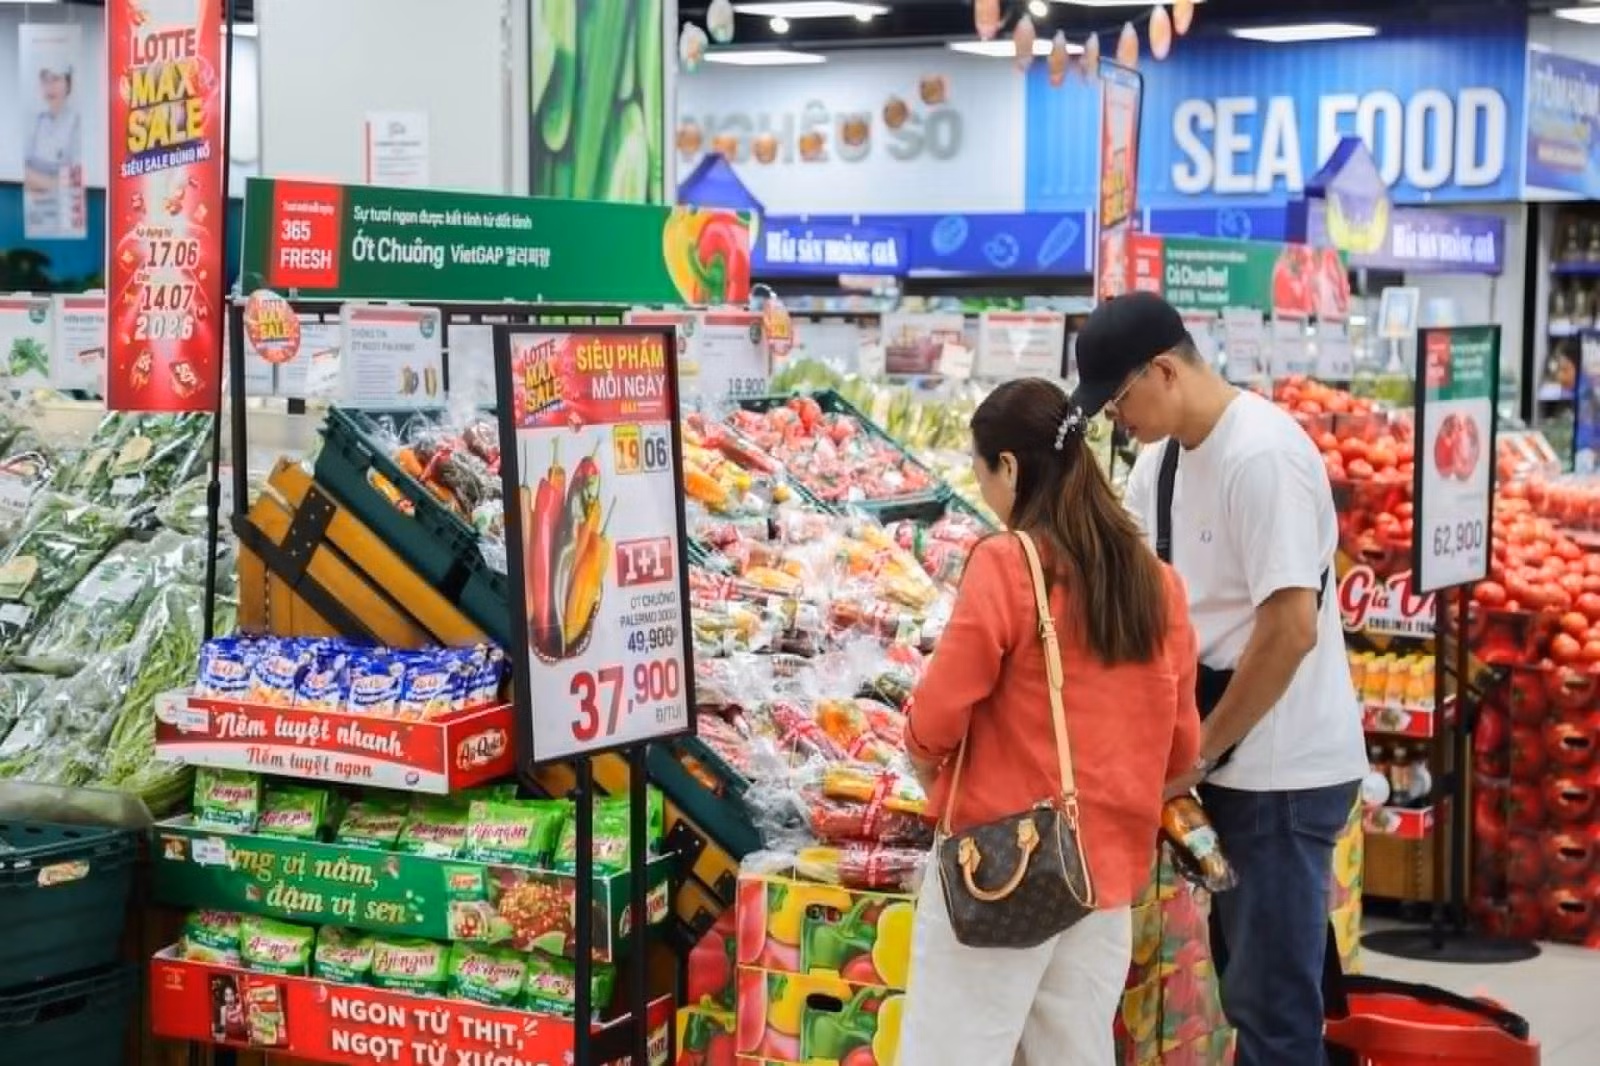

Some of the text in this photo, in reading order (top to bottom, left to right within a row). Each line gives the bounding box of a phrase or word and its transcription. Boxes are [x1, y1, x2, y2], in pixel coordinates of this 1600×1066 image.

[132, 29, 197, 65] LOTTE
[130, 61, 200, 108] MAX
[127, 98, 206, 153] SALE
[1171, 95, 1304, 194] SEA
[1318, 87, 1507, 190] FOOD
[121, 158, 144, 178] SIÊU
[144, 152, 169, 172] SALE
[281, 219, 311, 241] 365
[354, 205, 370, 224] Sự
[392, 210, 418, 226] ngon
[418, 208, 445, 228] được
[147, 240, 198, 267] 17.06
[280, 247, 332, 270] FRESH
[352, 228, 375, 262] Ớt
[378, 236, 445, 270] Chuông
[450, 243, 504, 265] VietGAP
[142, 284, 194, 311] 14.07
[525, 337, 556, 366] LOTTE
[576, 337, 614, 370] SIÊU
[617, 336, 665, 369] PHẨM
[525, 360, 556, 390] MAX
[592, 371, 666, 399] MỖI NGÀY
[525, 379, 563, 413] SALE
[617, 437, 667, 470] 19 06
[1434, 520, 1483, 558] 62,900
[623, 541, 666, 580] 1+1
[1340, 568, 1390, 629] Gia
[570, 657, 680, 742] 37,900
[274, 714, 331, 747] tuyệt
[336, 721, 404, 757] nhanh
[289, 750, 329, 776] tuyệt
[334, 760, 373, 779] ngon
[280, 853, 305, 881] vị
[266, 880, 408, 924] đậm vị sen
[331, 996, 525, 1050] NGON TỪ THỊT,
[331, 1029, 404, 1059] NGỌT
[412, 1037, 448, 1066] TỪ
